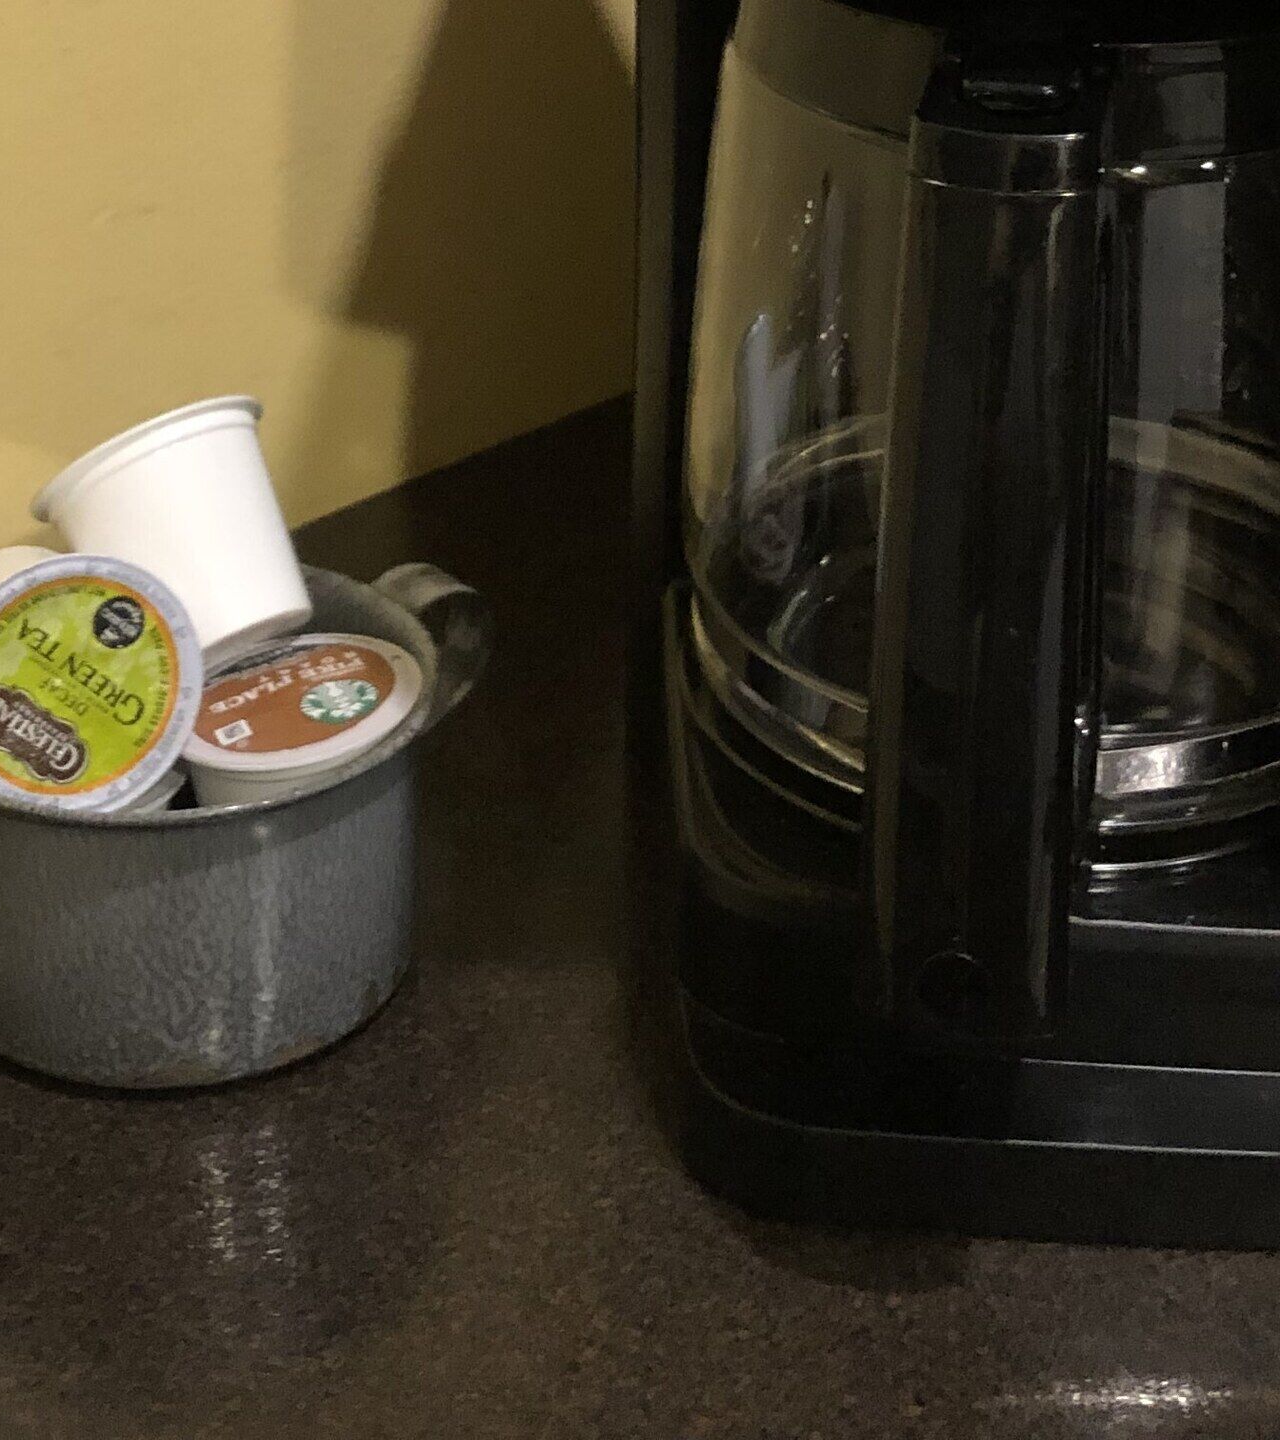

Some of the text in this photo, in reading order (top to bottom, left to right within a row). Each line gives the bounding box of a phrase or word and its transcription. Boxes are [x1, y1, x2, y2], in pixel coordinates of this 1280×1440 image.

[19, 618, 62, 662] TEA
[60, 653, 144, 726] GREEN
[209, 673, 294, 714] PLACE
